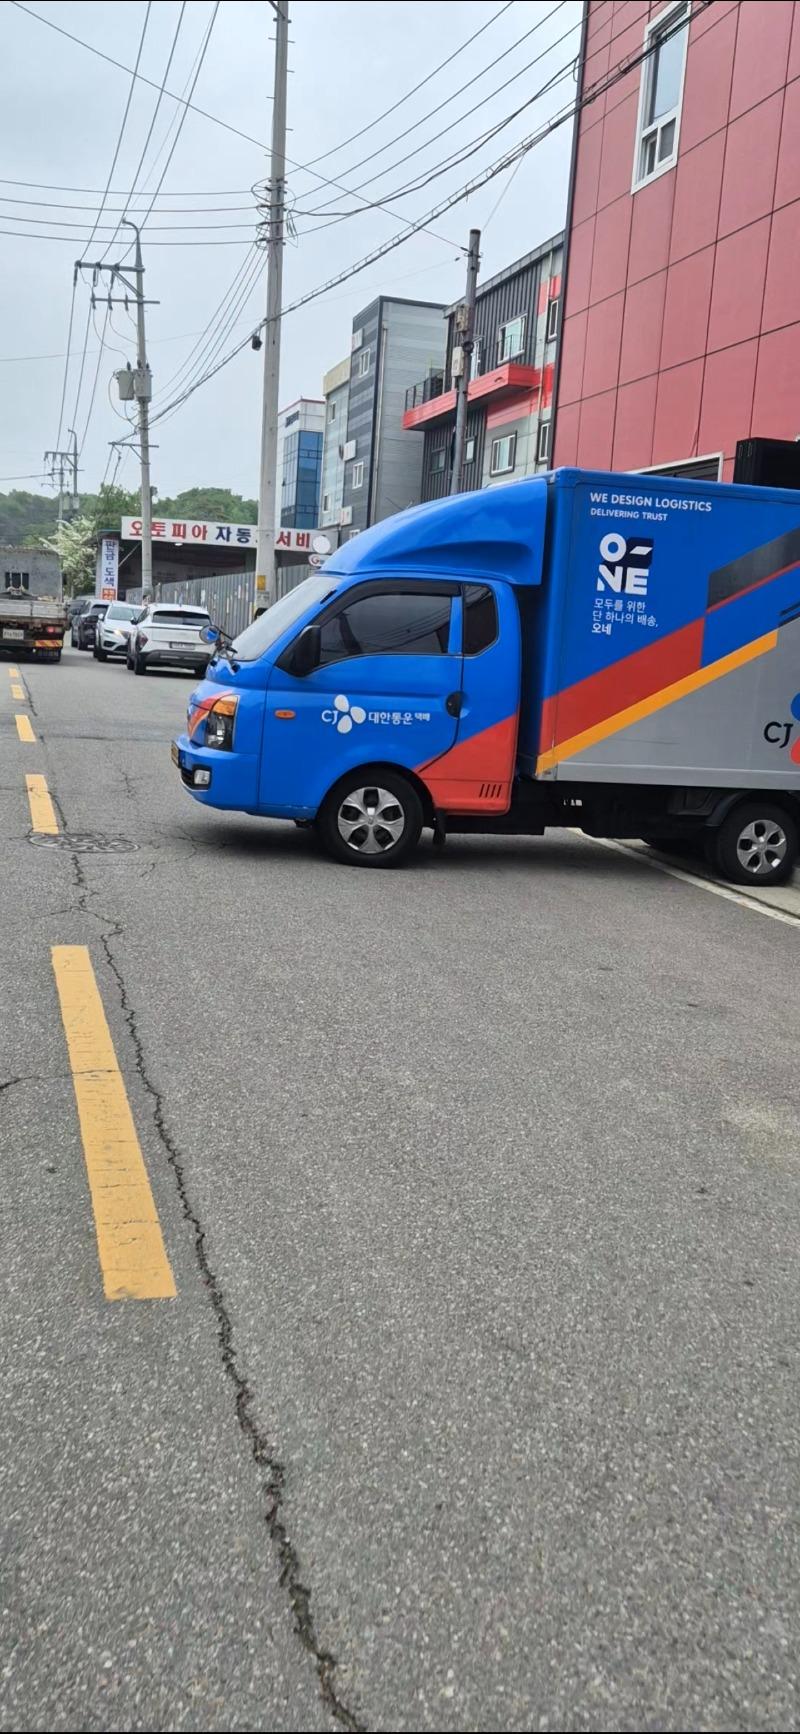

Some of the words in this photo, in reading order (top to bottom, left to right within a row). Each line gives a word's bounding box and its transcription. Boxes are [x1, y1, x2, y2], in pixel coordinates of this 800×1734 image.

[590, 492, 608, 503] WE
[611, 494, 652, 507] DESIGN
[655, 497, 712, 512] LOGISTICS
[590, 508, 640, 519] DELIVERING
[642, 511, 668, 521] TRUST
[129, 521, 208, 540] 오토피아
[215, 526, 258, 545] 자동
[276, 531, 327, 549] 서비
[594, 598, 623, 611] 모두를
[627, 600, 646, 614] 위한
[592, 610, 602, 622] 단
[605, 611, 634, 624] 하나의
[592, 622, 612, 635] 오네
[321, 709, 339, 725] CJ
[368, 711, 413, 725] 대한통운
[763, 721, 794, 749] CJ
